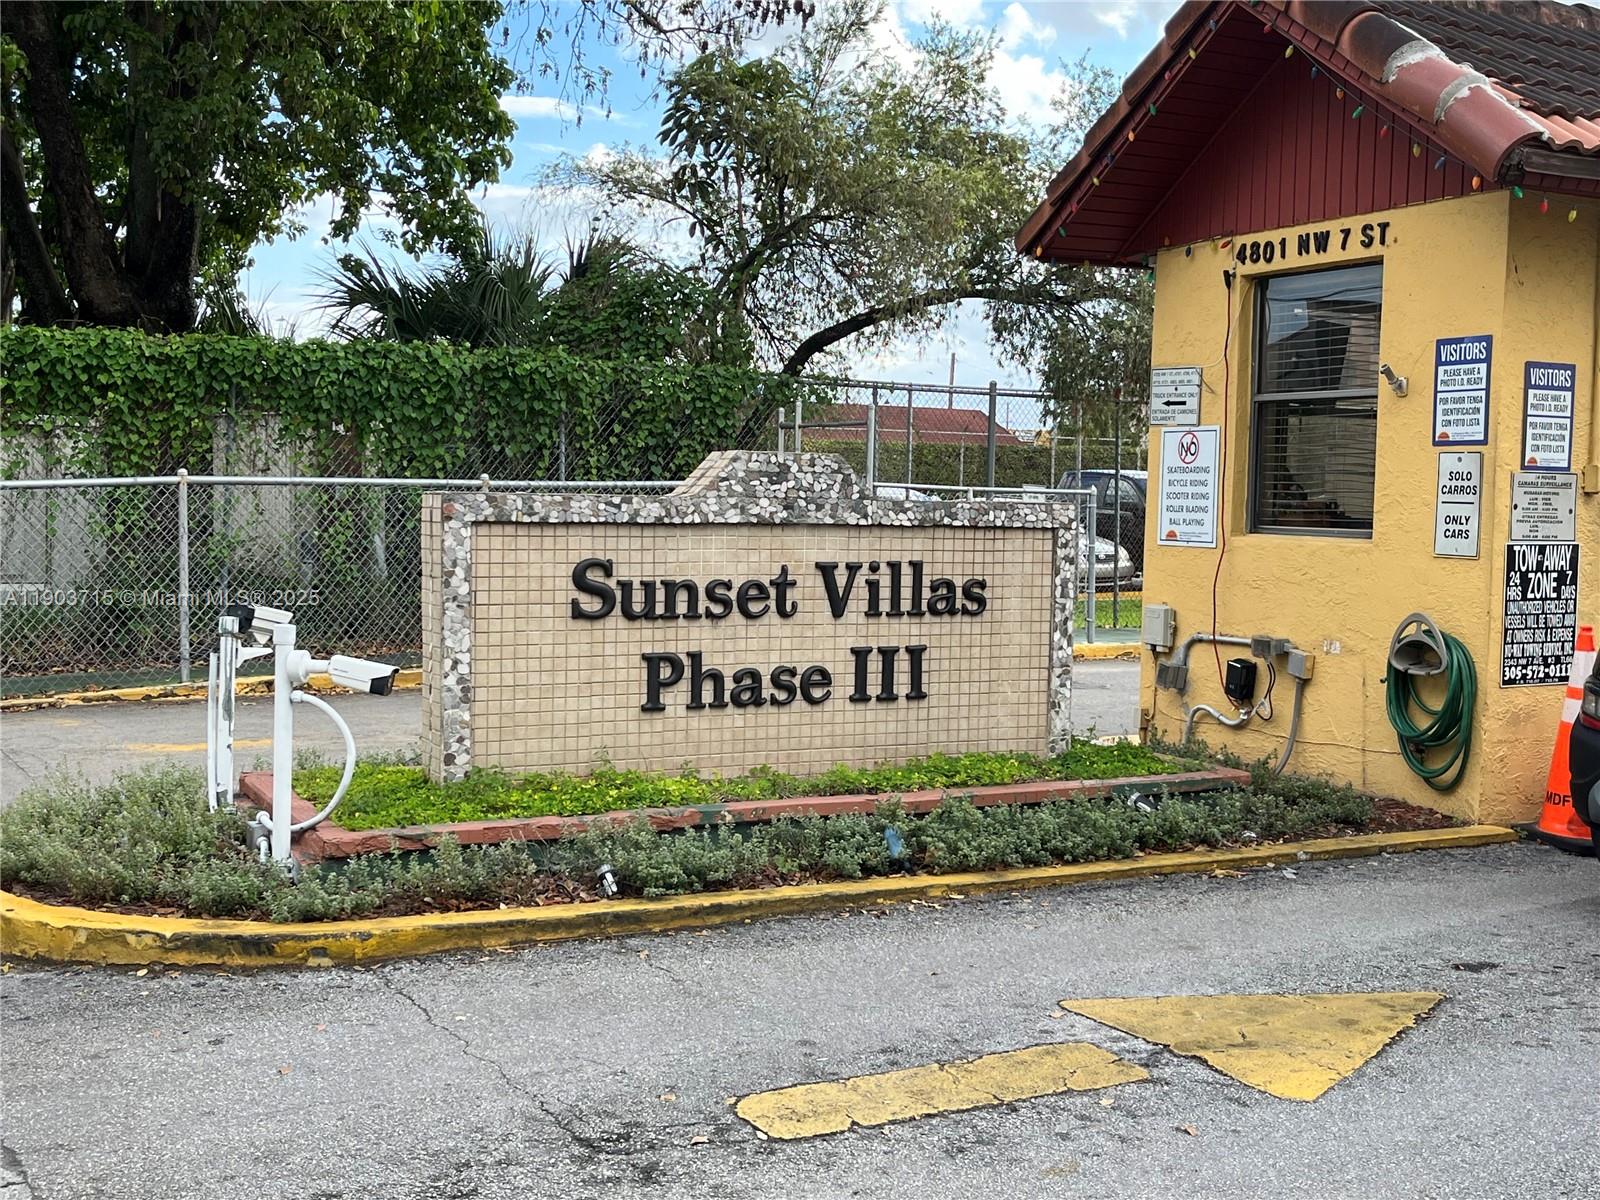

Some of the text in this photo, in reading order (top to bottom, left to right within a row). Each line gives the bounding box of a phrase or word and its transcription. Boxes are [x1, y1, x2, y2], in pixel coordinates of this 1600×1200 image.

[1236, 221, 1390, 265] 4801 NW 7 ST
[1440, 341, 1487, 362] VISITORS
[1443, 367, 1481, 377] PLEASE HAVE A
[1530, 367, 1571, 387] VISITORS
[1440, 378, 1456, 387] PHOTO
[1467, 377, 1483, 386] READY
[1439, 395, 1483, 405] POR FAVOR TENGA
[1533, 393, 1567, 402] PLEASE HAVE A
[1530, 402, 1545, 411] PHOTO
[1553, 404, 1568, 412] READY
[1441, 418, 1480, 427] CON FOTO LISTA
[1529, 421, 1568, 431] POR FAVOR TENGA
[1180, 441, 1197, 456] NO
[1531, 444, 1565, 453] CON FOTO LISTA
[1167, 466, 1210, 474] SKATEBOARDING
[1448, 471, 1472, 482] SOLO
[1168, 479, 1208, 487] BICYCLE RIDING
[1166, 492, 1209, 500] SCOOTER RIDING
[1441, 484, 1477, 496] CARROS
[1185, 505, 1208, 513] BLADING
[1182, 518, 1204, 526] PLAYING
[1444, 515, 1471, 526] ONLY
[1443, 529, 1470, 539] CARS
[1513, 545, 1572, 571] TOW-AWAY
[1509, 571, 1520, 586] 24
[1566, 571, 1572, 585] 7
[572, 558, 987, 620] Sunset Villas
[1527, 572, 1558, 599] ZONE
[1507, 586, 1522, 600] HRS
[1560, 585, 1575, 599] DAYS
[1507, 600, 1574, 614] UNAUTHORIZED VEHICLES OR
[1505, 615, 1526, 628] VESSELS
[1526, 614, 1537, 628] WILL
[1538, 614, 1545, 628] BE
[1546, 614, 1563, 628] TOWED
[1506, 630, 1512, 643] AT
[1513, 629, 1533, 643] OWNERS
[1534, 629, 1546, 642] RISK
[1552, 628, 1573, 641] EXPENSE
[1524, 643, 1542, 657] TOWING
[641, 645, 928, 712] Phase III
